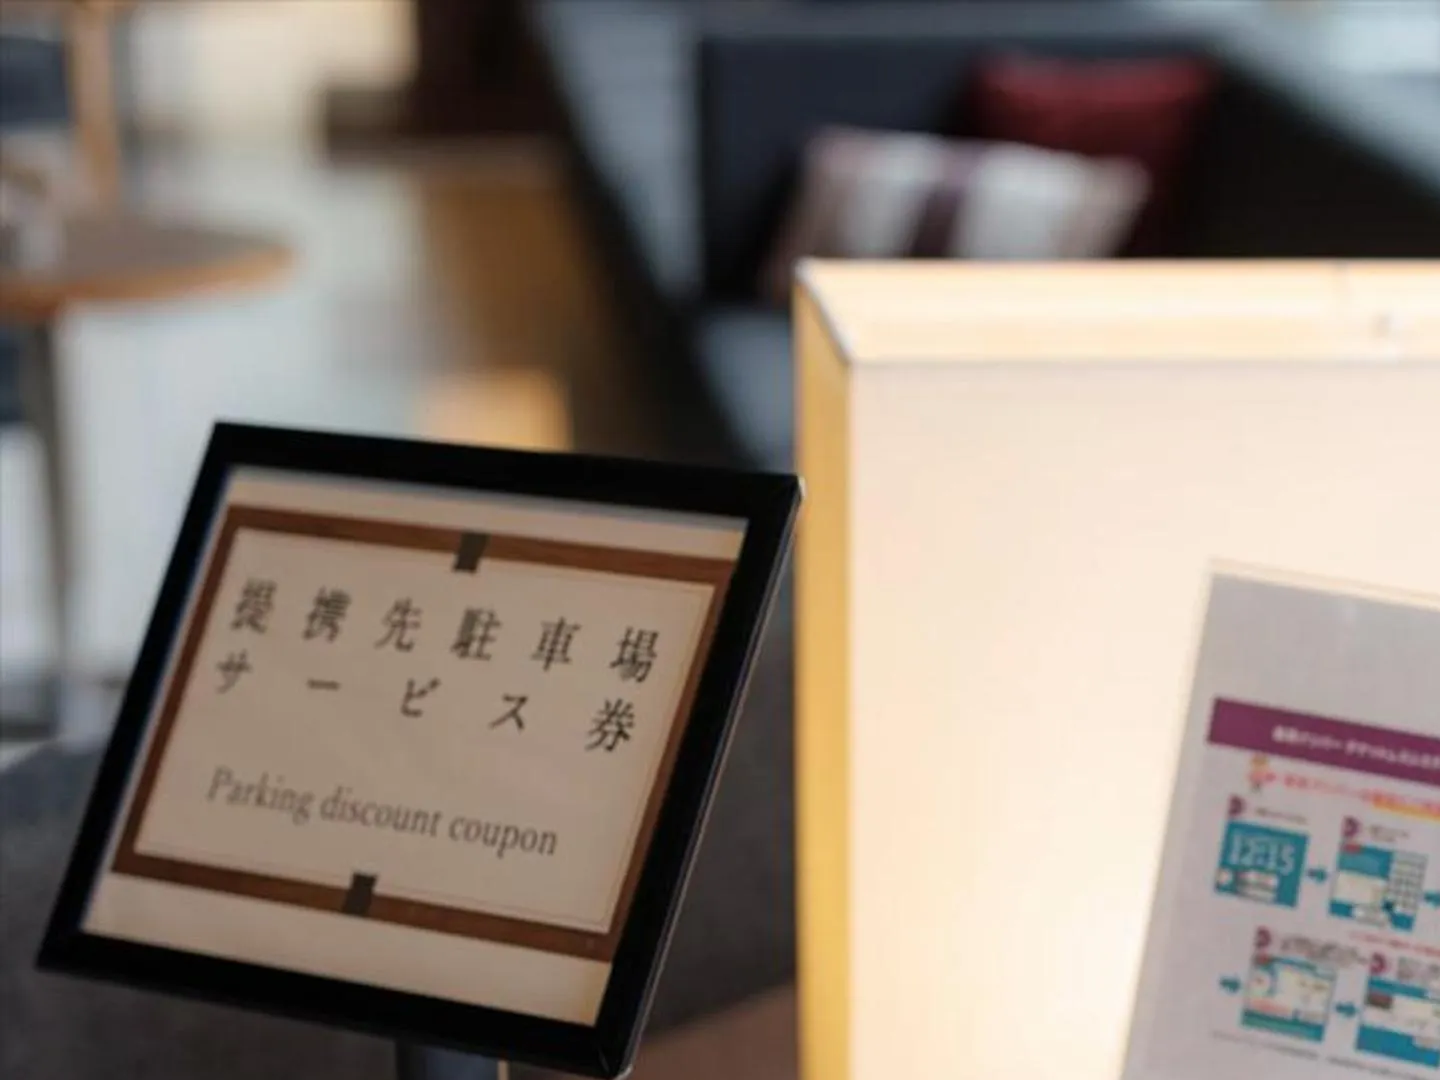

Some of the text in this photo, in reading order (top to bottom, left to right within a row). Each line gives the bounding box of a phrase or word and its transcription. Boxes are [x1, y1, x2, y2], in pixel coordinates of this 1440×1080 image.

[227, 579, 660, 685] 提携先駐車場
[213, 652, 636, 756] サービス券
[208, 766, 559, 861] Parking discount coupon
